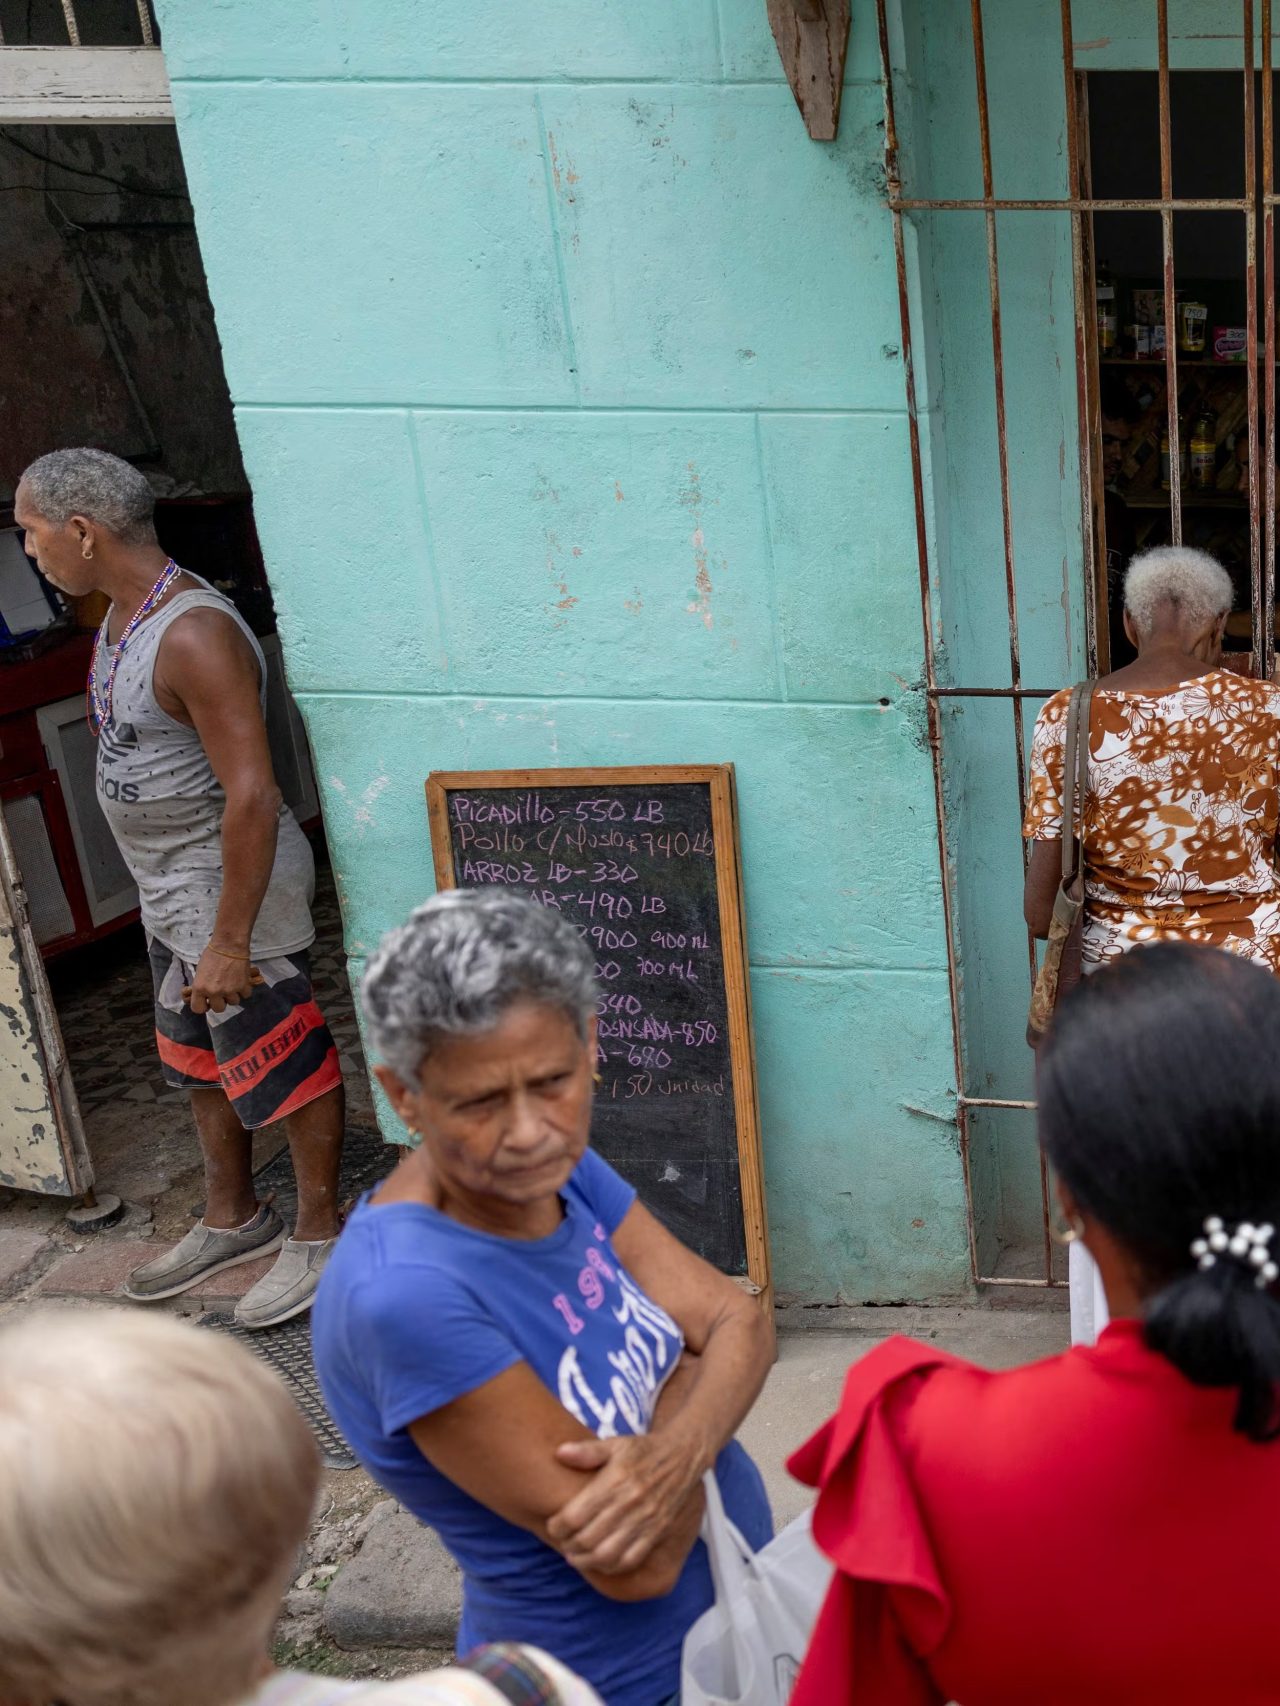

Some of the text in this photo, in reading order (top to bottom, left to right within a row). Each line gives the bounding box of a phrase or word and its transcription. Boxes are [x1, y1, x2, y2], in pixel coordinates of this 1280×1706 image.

[98, 766, 140, 803] das
[454, 823, 524, 853] Pollo
[463, 860, 540, 884] ARROZ
[641, 896, 667, 914] LB
[650, 931, 687, 949] 900
